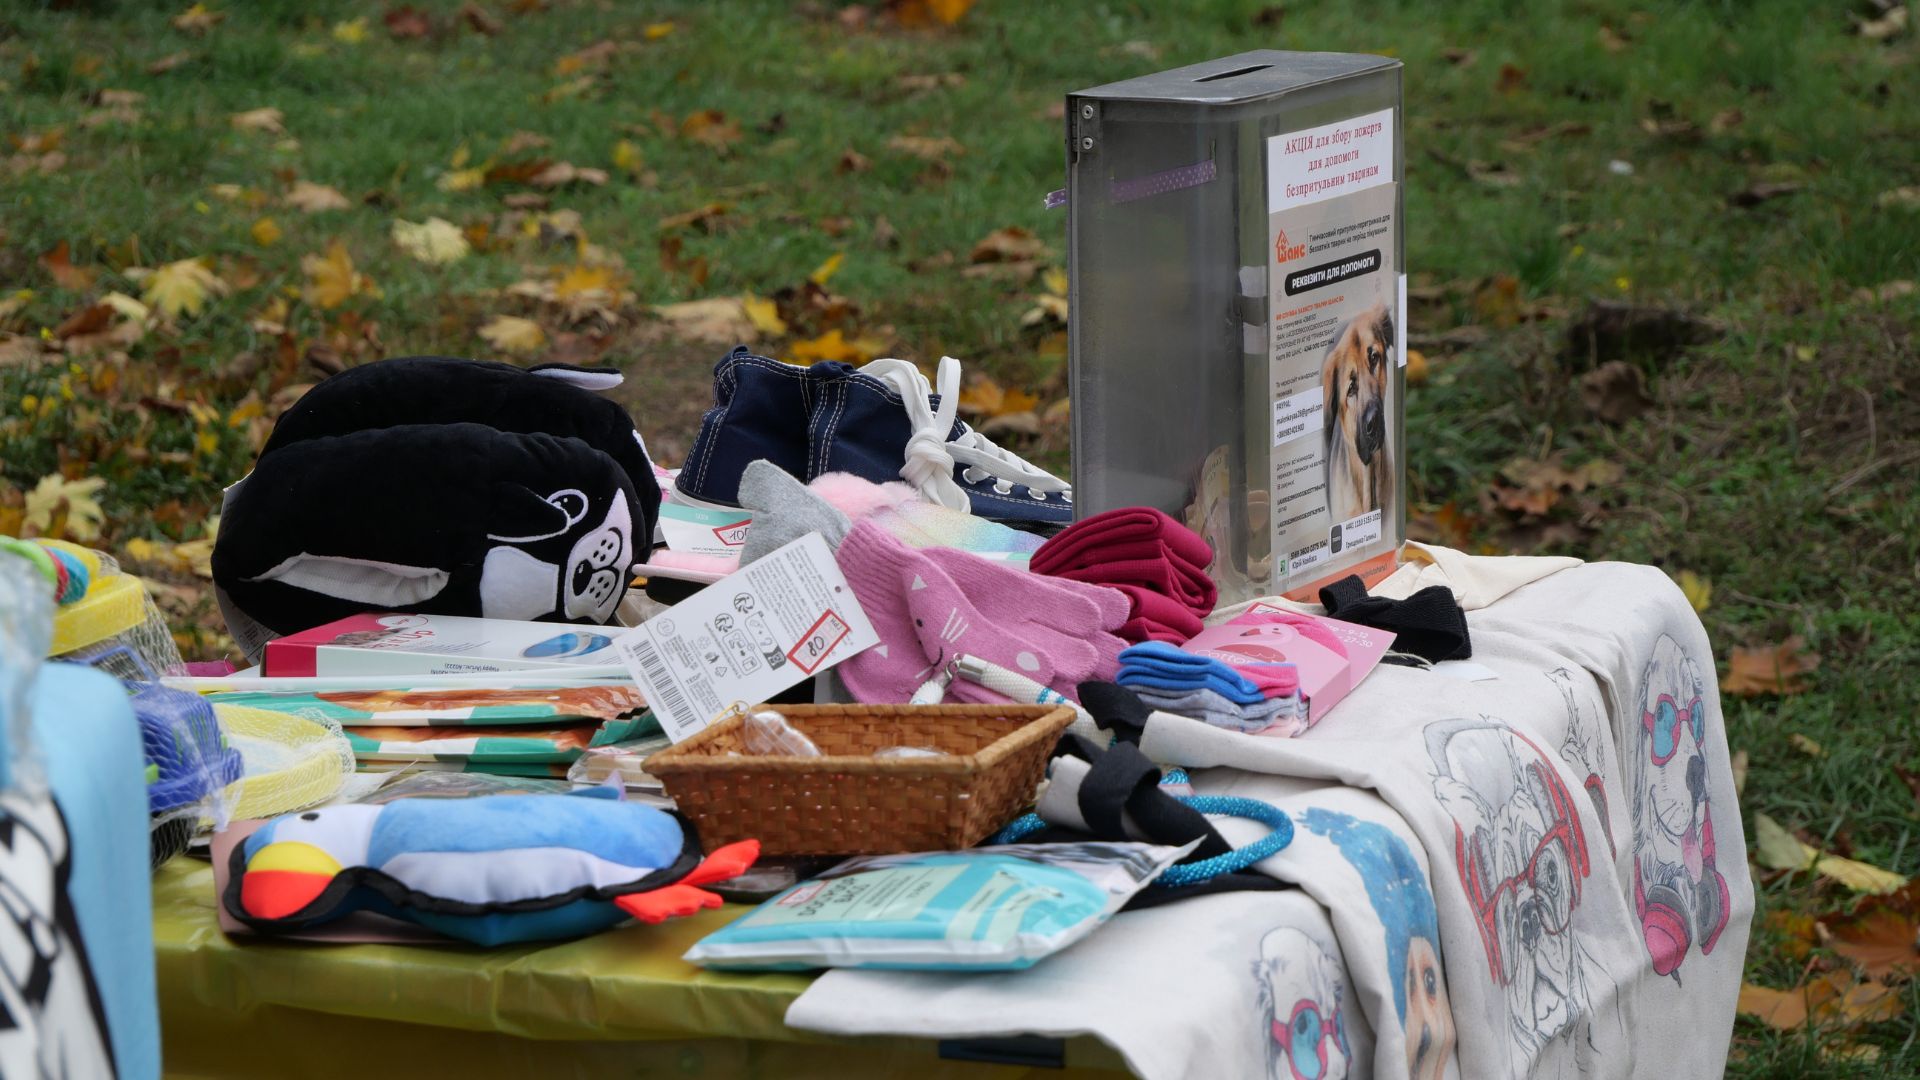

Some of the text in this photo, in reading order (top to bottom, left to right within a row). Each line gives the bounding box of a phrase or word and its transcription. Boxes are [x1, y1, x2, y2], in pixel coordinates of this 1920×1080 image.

[1284, 122, 1383, 155] АКЦІЯ для збору пожертв
[1308, 150, 1359, 173] для допомоги
[1286, 165, 1379, 198] безпритульним тваринам
[1352, 232, 1368, 247] період
[1292, 256, 1375, 289] РЕКВІЗИТИ ДЛЯ ДОПОМОГИ
[807, 634, 825, 657] 80
